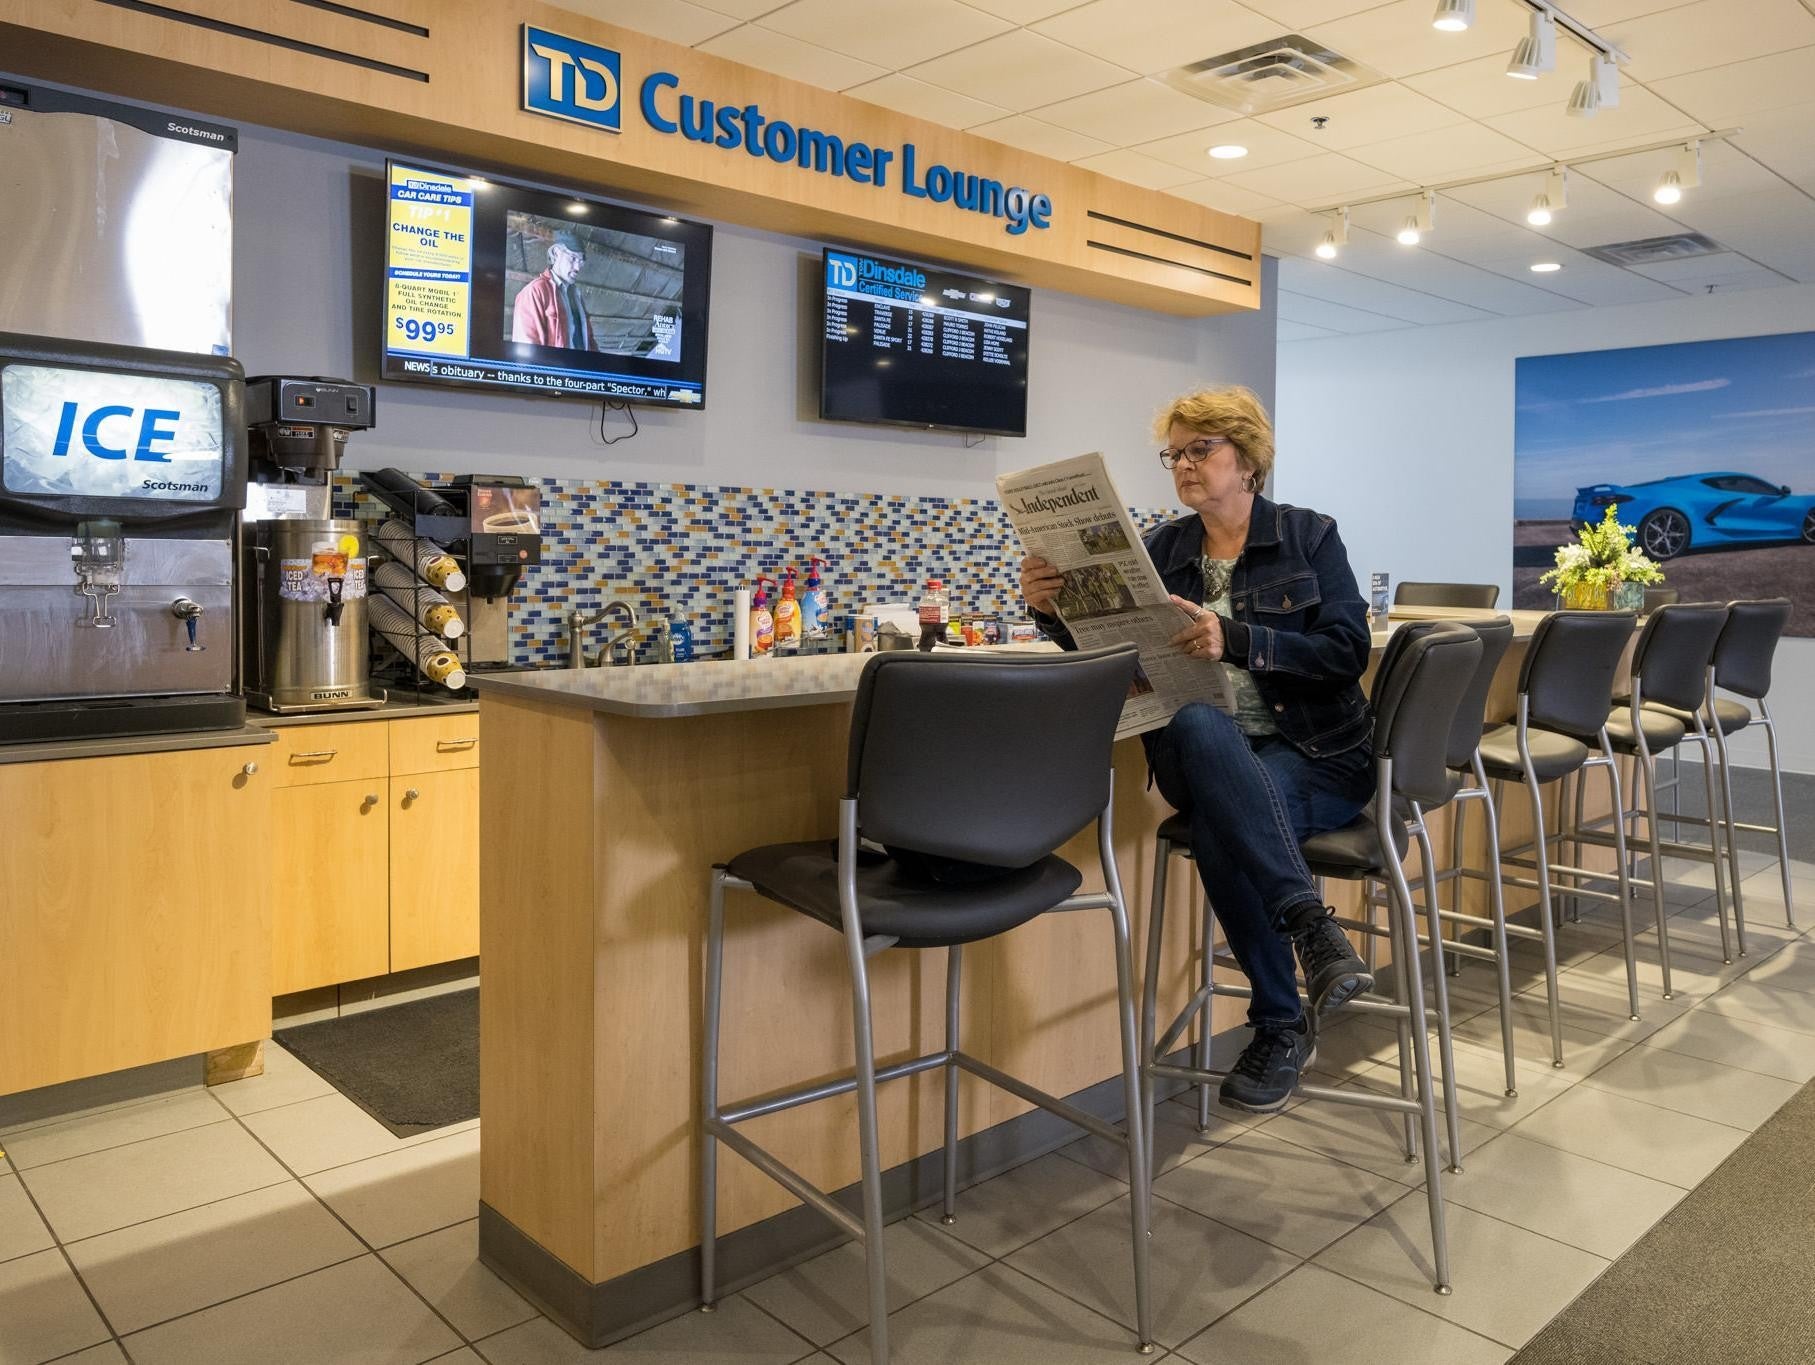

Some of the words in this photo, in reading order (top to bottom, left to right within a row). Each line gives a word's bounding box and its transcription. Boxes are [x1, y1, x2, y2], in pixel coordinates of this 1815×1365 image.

[531, 43, 618, 112] TD
[167, 122, 226, 142] Scotsman
[639, 72, 893, 187] Customer
[902, 144, 1052, 235] Lounge
[398, 190, 417, 198] CAR
[418, 193, 442, 202] CARE
[443, 195, 463, 204] TIPS
[393, 222, 440, 238] CHANGE
[444, 231, 466, 243] THE
[420, 238, 438, 248] OIL
[829, 258, 857, 286] TD
[864, 259, 926, 289] Dinsdale
[428, 287, 450, 296] MOBIL
[859, 281, 893, 298] Certified
[398, 291, 415, 299] FULL
[418, 293, 457, 304] SYNTHETIC
[420, 300, 449, 309] CHANGE
[409, 306, 426, 314] TIRE
[404, 361, 430, 372] NEWS
[432, 366, 438, 374] s
[441, 365, 485, 380] obituary
[498, 371, 532, 383] thanks
[534, 375, 544, 384] to
[547, 376, 563, 386] the
[565, 378, 605, 391] four-part
[653, 387, 665, 397] wh
[53, 402, 180, 463] ICE
[142, 479, 209, 493] Scotsman
[1010, 485, 1100, 514] Independent
[1018, 524, 1058, 536] Mid-American
[1058, 519, 1074, 528] Stock
[1074, 516, 1092, 526] Show
[1093, 512, 1116, 522] debuts
[286, 571, 303, 581] ICED
[287, 582, 302, 591] TEA
[314, 691, 349, 700] BUNN
